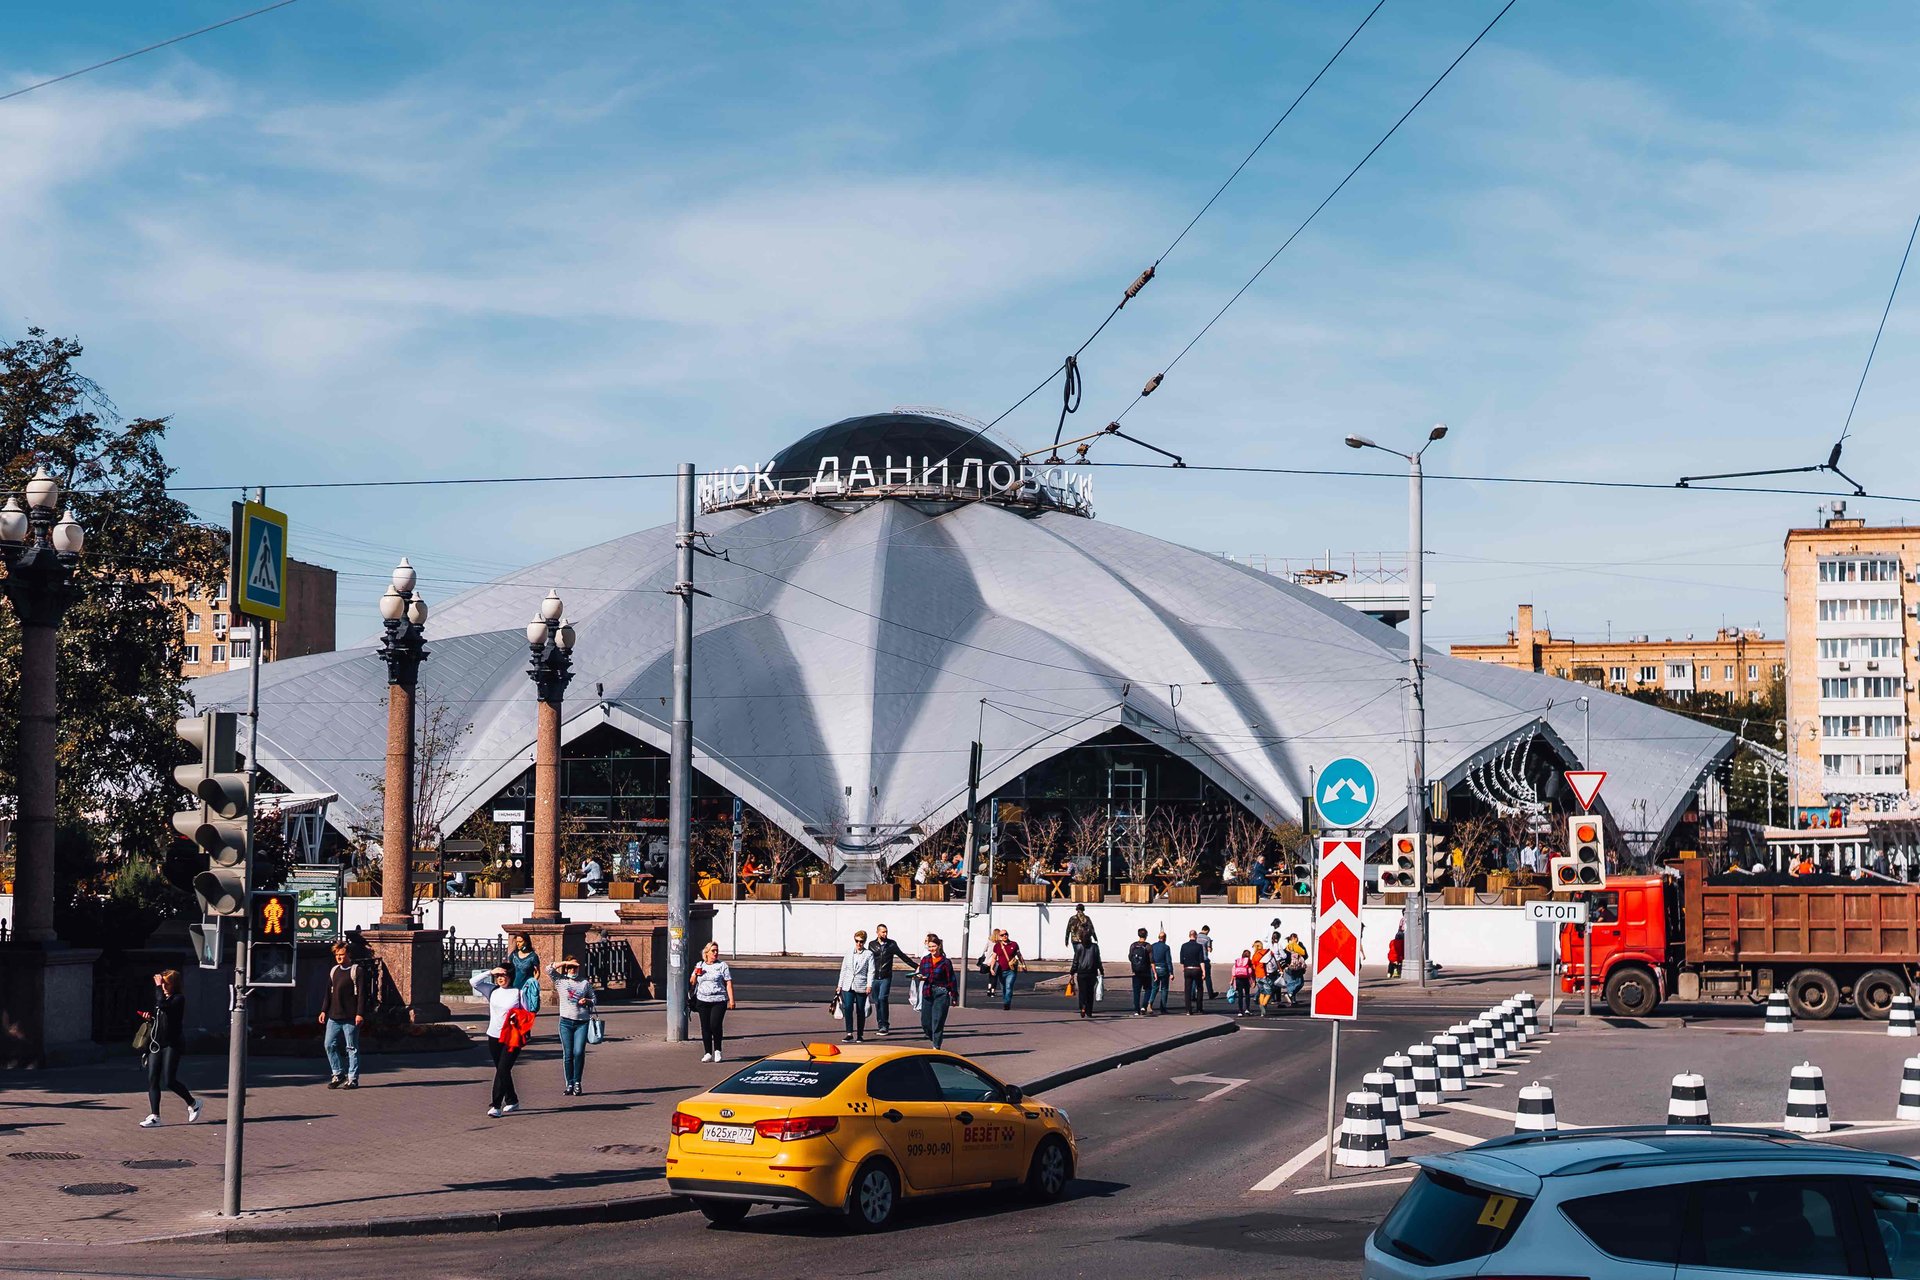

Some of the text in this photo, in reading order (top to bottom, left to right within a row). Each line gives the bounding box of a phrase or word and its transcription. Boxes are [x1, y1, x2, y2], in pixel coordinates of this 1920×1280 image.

[1533, 905, 1577, 919] СТОП
[907, 1128, 925, 1140] (495)
[964, 1122, 1000, 1142] ВЕЗЁТ
[907, 1142, 951, 1157] 909-90-90
